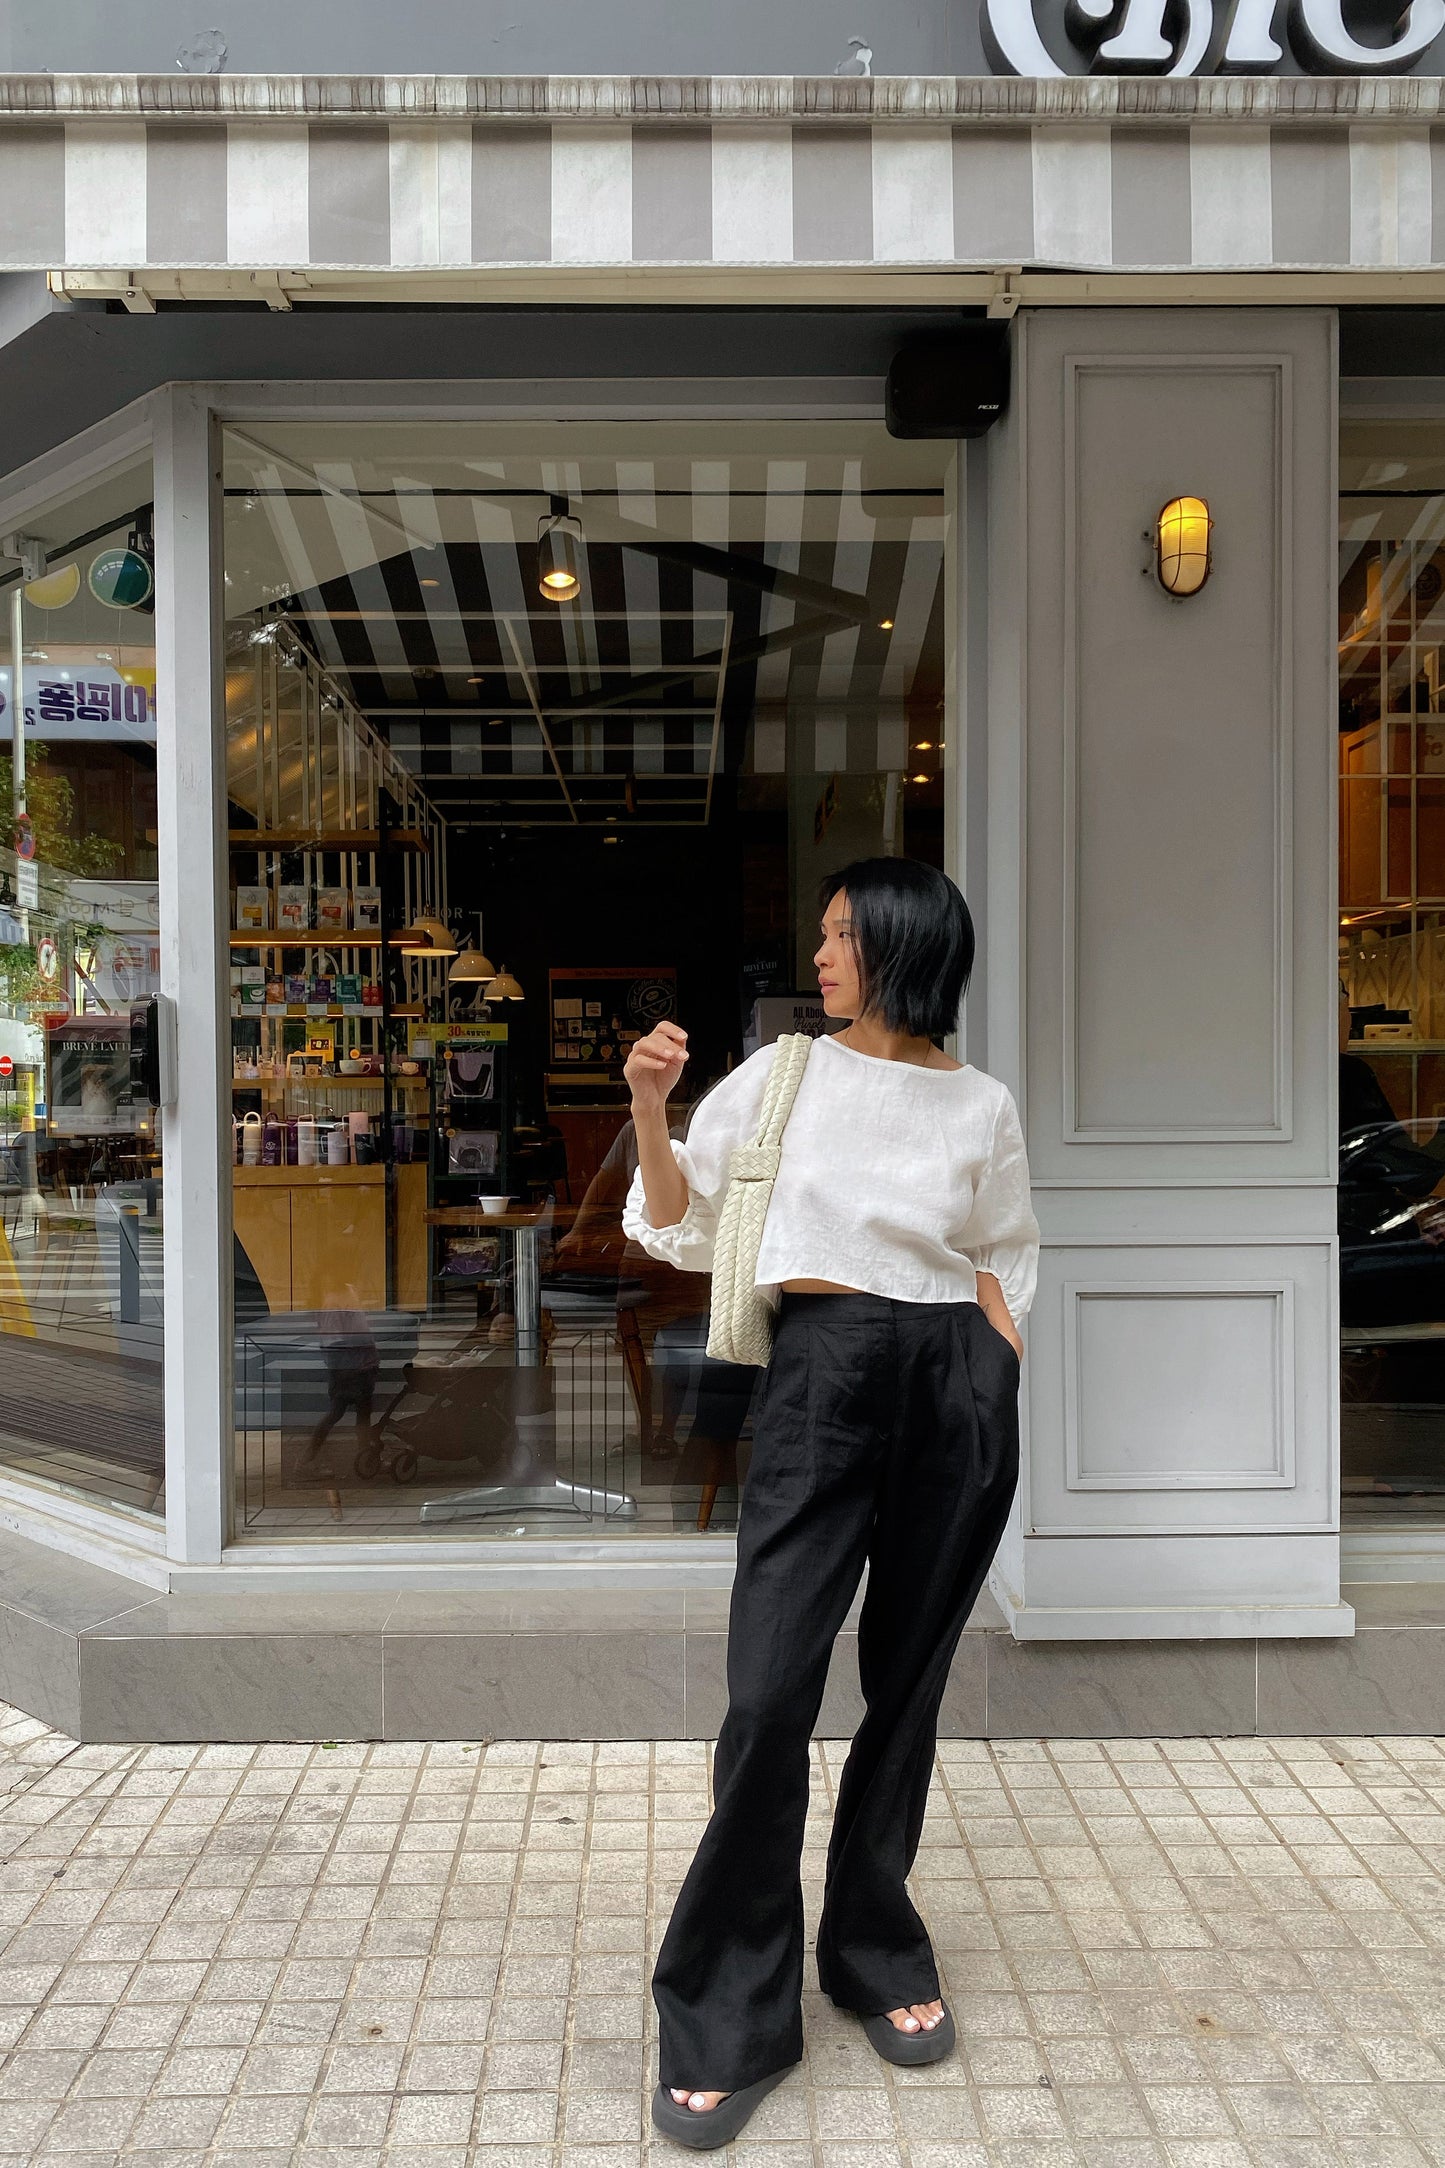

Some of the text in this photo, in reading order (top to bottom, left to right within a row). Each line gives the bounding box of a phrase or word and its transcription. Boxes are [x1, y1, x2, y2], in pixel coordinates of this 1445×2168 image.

[793, 1007, 828, 1019] All Abou
[62, 1042, 98, 1051] BREVE
